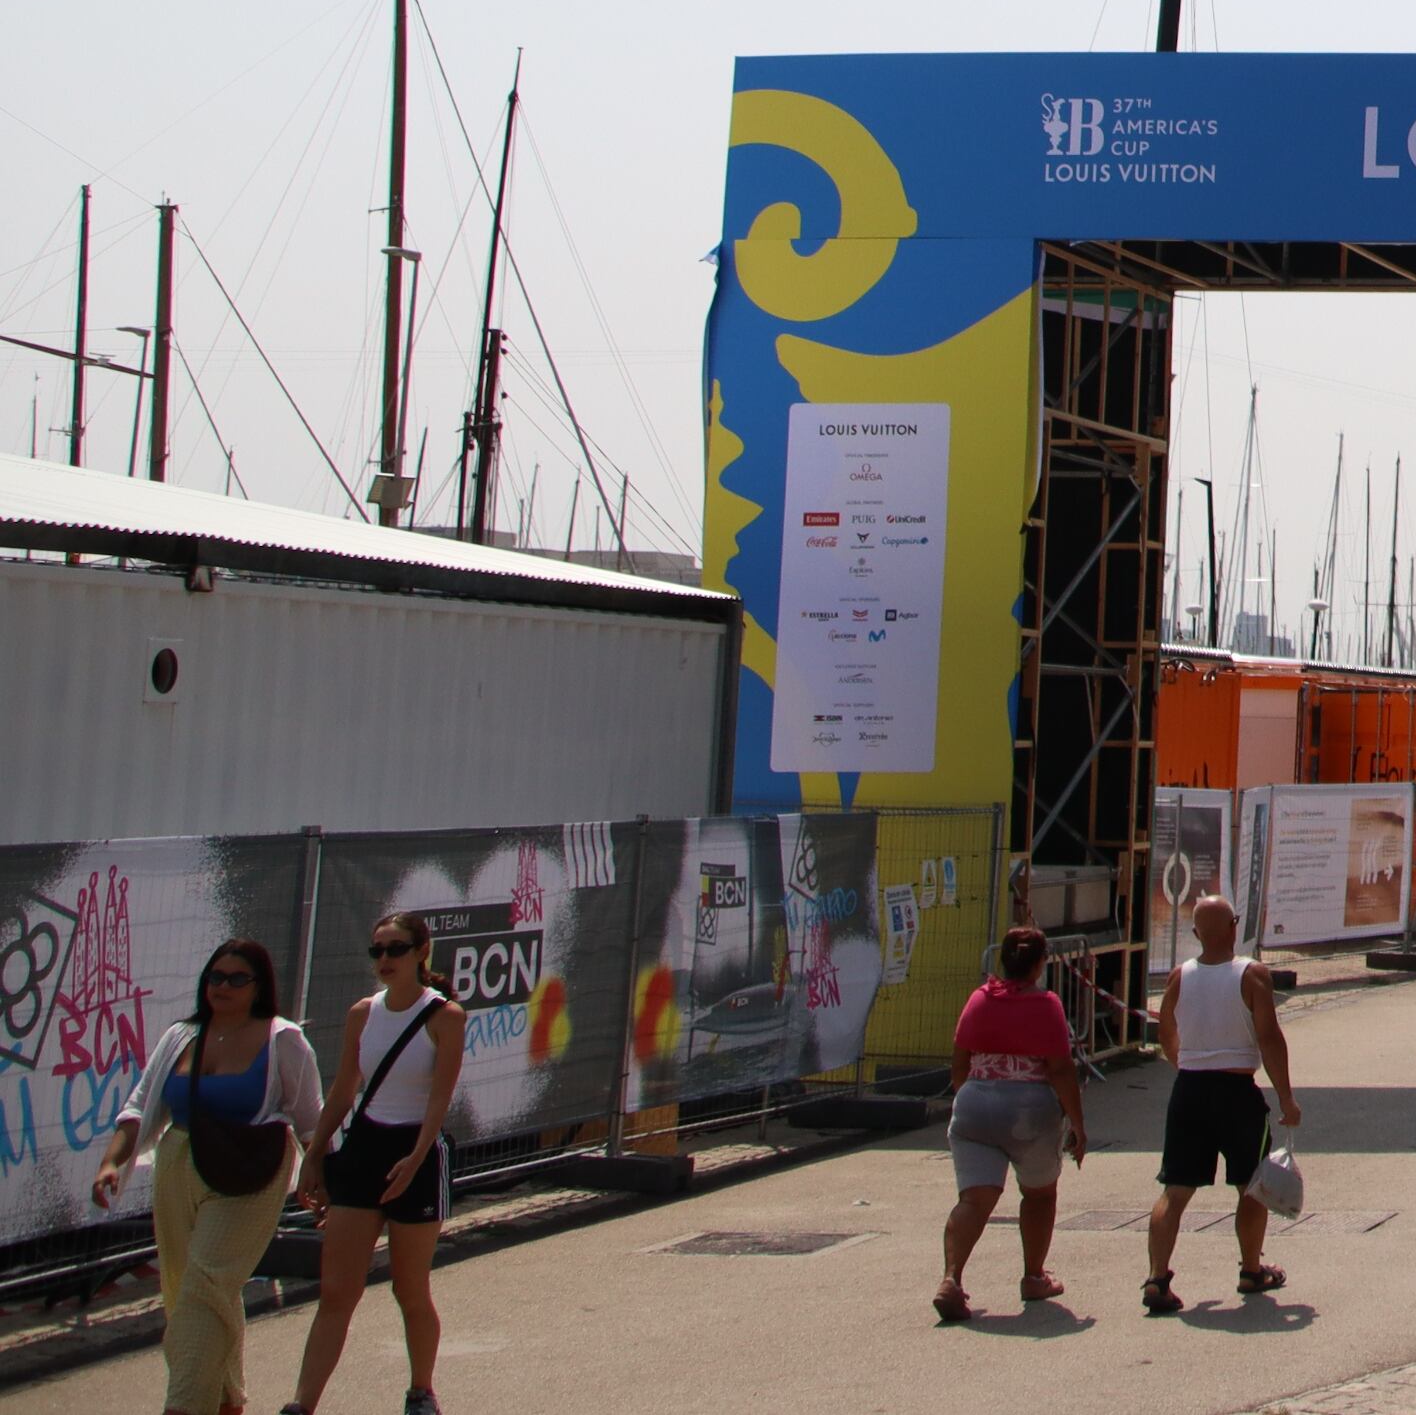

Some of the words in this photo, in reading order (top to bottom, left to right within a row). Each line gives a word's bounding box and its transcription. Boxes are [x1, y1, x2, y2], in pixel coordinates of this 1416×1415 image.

[1112, 98, 1152, 114] 37TH
[1112, 120, 1218, 135] AMERICA'S
[1111, 140, 1150, 156] CUP
[1044, 163, 1111, 183] LOUIS
[1118, 164, 1217, 183] VUITTON
[819, 424, 857, 436] LOUIS
[861, 424, 918, 436] VUITTON
[849, 473, 882, 481] OMEGA
[806, 515, 837, 523] Emirates
[852, 515, 876, 524] PUIG
[895, 515, 926, 524] UniCredit
[715, 880, 745, 905] BCN
[439, 913, 470, 931] TEAM
[452, 940, 539, 1002] BCN
